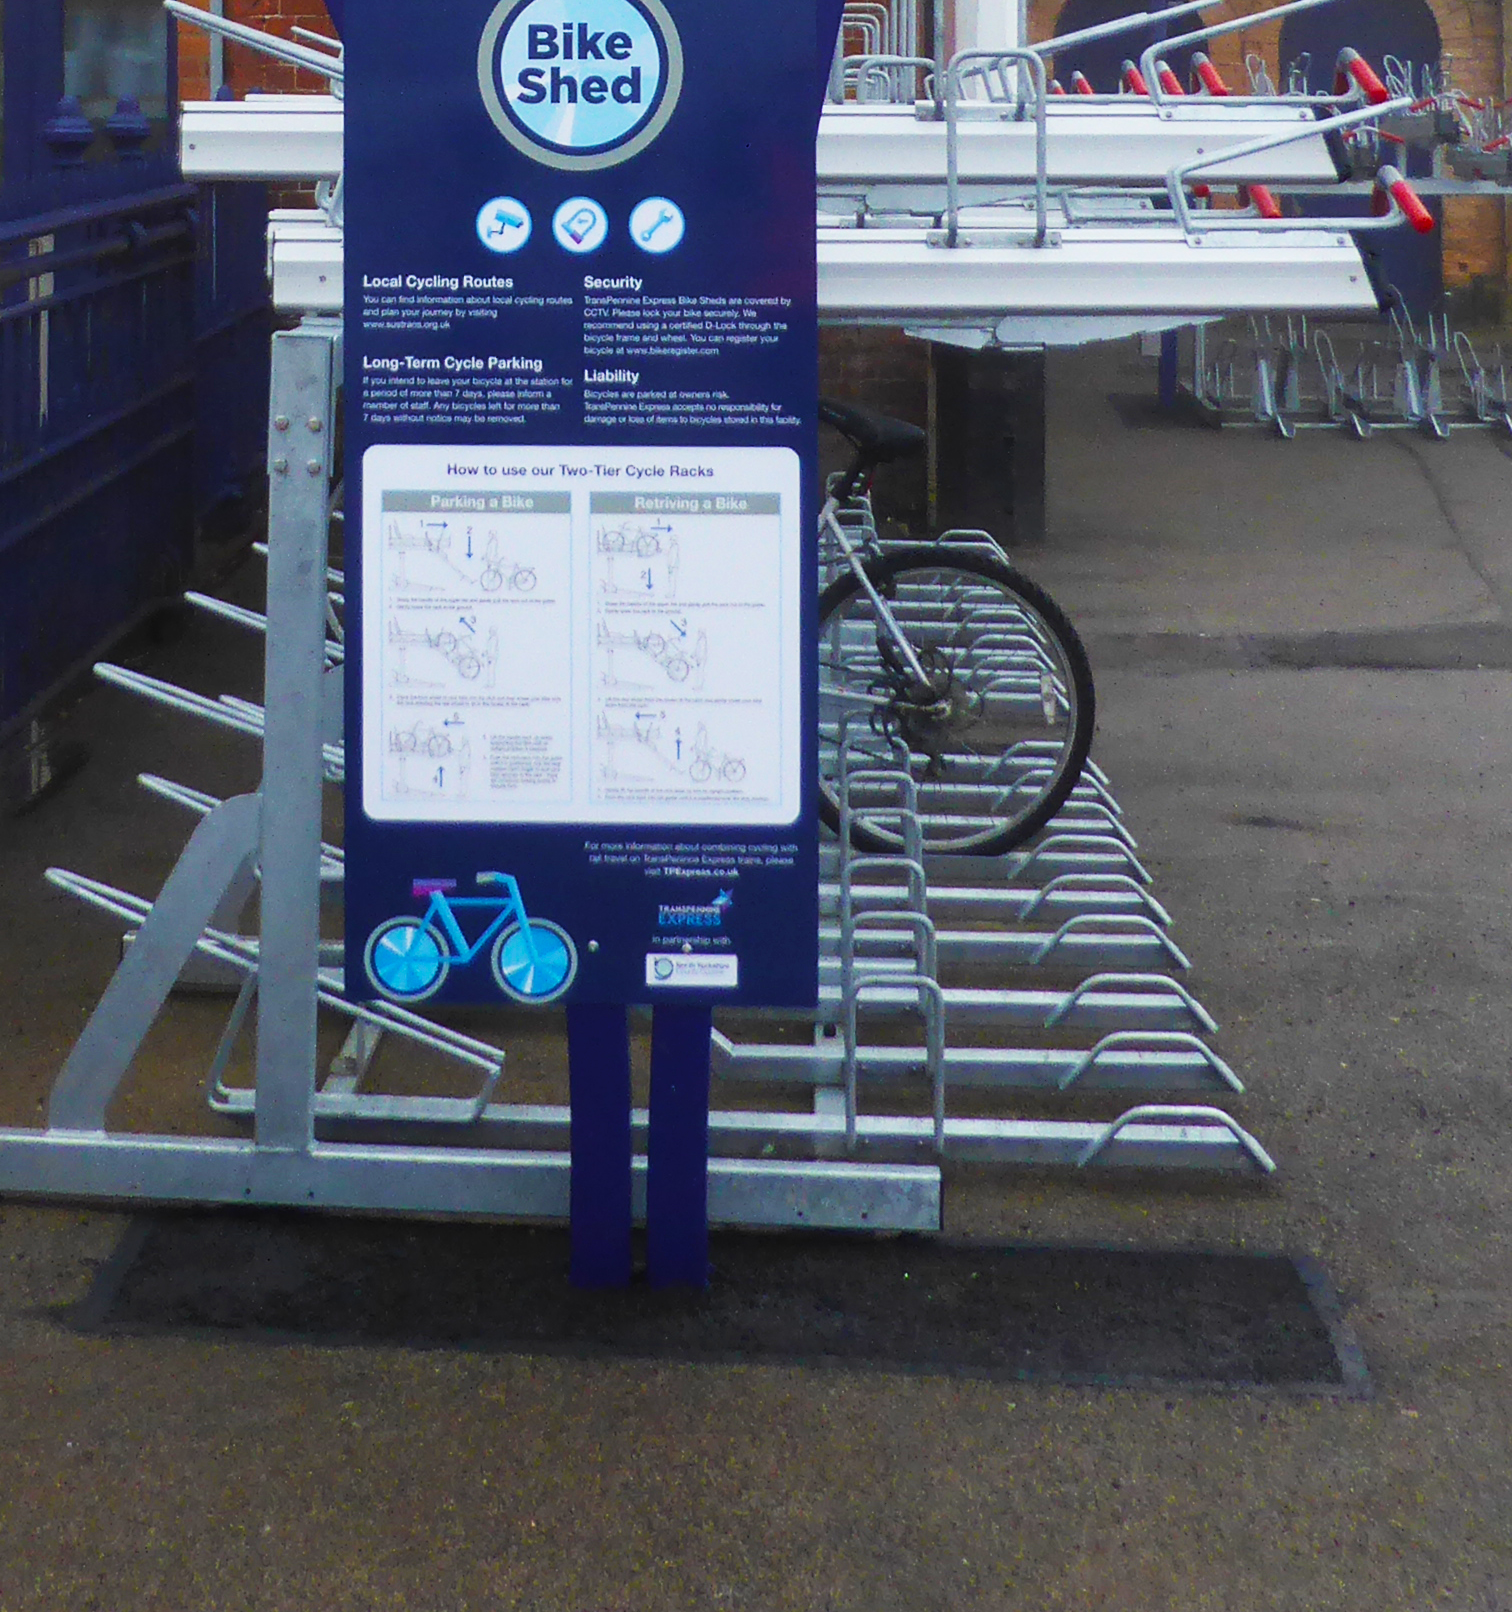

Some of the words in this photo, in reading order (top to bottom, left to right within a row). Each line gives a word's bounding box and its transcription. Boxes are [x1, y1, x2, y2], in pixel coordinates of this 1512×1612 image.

[528, 23, 632, 60] Bike
[517, 66, 641, 104] Shed
[363, 275, 402, 288] Local
[406, 275, 458, 290] Cycling
[463, 276, 513, 288] Routes
[584, 276, 642, 290] Security
[364, 296, 379, 304] You
[399, 296, 415, 304] find
[417, 296, 464, 304] information
[466, 296, 490, 304] about
[493, 296, 512, 304] local
[514, 296, 544, 307] cycling
[546, 296, 573, 305] routes
[585, 296, 640, 305] TransPennine
[642, 297, 676, 307] Express
[678, 297, 697, 305] Bike
[700, 297, 726, 305] Sheds
[744, 297, 778, 305] covered
[780, 297, 791, 308] by
[363, 308, 379, 316] and
[381, 308, 399, 318] plan
[402, 310, 420, 319] your
[422, 308, 453, 319] journey
[456, 308, 466, 319] by
[469, 308, 497, 319] visiting
[584, 309, 609, 317] CCTV.
[612, 309, 640, 317] Please
[643, 309, 660, 317] lock
[663, 311, 680, 319] your
[684, 309, 701, 317] bike
[743, 309, 756, 317] We
[584, 322, 634, 330] recommend
[636, 322, 659, 332] using
[739, 322, 771, 332] through
[774, 322, 787, 330] the
[584, 334, 614, 344] bicycle
[616, 334, 640, 342] frame
[642, 334, 658, 342] and
[691, 334, 706, 342] You
[726, 334, 757, 345] register
[760, 336, 778, 345] your
[584, 347, 614, 357] bicycle
[616, 347, 624, 355] at
[363, 356, 440, 372] Long-Term
[444, 356, 484, 371] Cycle
[488, 357, 542, 372] Parking
[363, 377, 368, 385] If
[371, 379, 386, 388] you
[417, 377, 426, 386] to
[428, 377, 450, 386] leave
[452, 379, 470, 388] your
[472, 378, 502, 388] bicycle
[504, 378, 512, 386] at
[515, 378, 528, 386] the
[530, 378, 559, 386] station
[561, 378, 572, 386] for
[584, 370, 639, 384] Liability
[399, 390, 408, 398] of
[434, 390, 452, 398] than
[488, 390, 515, 400] please
[584, 390, 619, 400] Bicycles
[637, 390, 666, 401] parked
[669, 390, 677, 398] at
[363, 402, 397, 410] member
[400, 402, 408, 410] of
[434, 402, 449, 413] Any
[452, 402, 486, 413] bicycles
[488, 402, 502, 411] left
[504, 402, 515, 411] for
[541, 402, 560, 411] than
[585, 403, 637, 411] TransPennine
[639, 403, 670, 413] Express
[672, 403, 704, 413] accepts
[771, 403, 781, 411] for
[371, 414, 391, 424] days
[394, 414, 424, 422] without
[426, 414, 452, 422] notice
[454, 416, 472, 425] may
[474, 414, 485, 422] be
[448, 465, 478, 475] How
[483, 465, 497, 475] to
[502, 467, 526, 476] use
[532, 468, 555, 476] our
[559, 465, 621, 476] Two-Tier
[626, 465, 664, 477] Cycle
[670, 466, 713, 476] Racks
[431, 495, 485, 510] Parking
[502, 495, 534, 508] Bike
[635, 496, 699, 512] Retriving
[715, 497, 747, 510] Bike
[659, 914, 721, 926] EXPRESS
[652, 936, 660, 944] in
[713, 936, 731, 944] with
